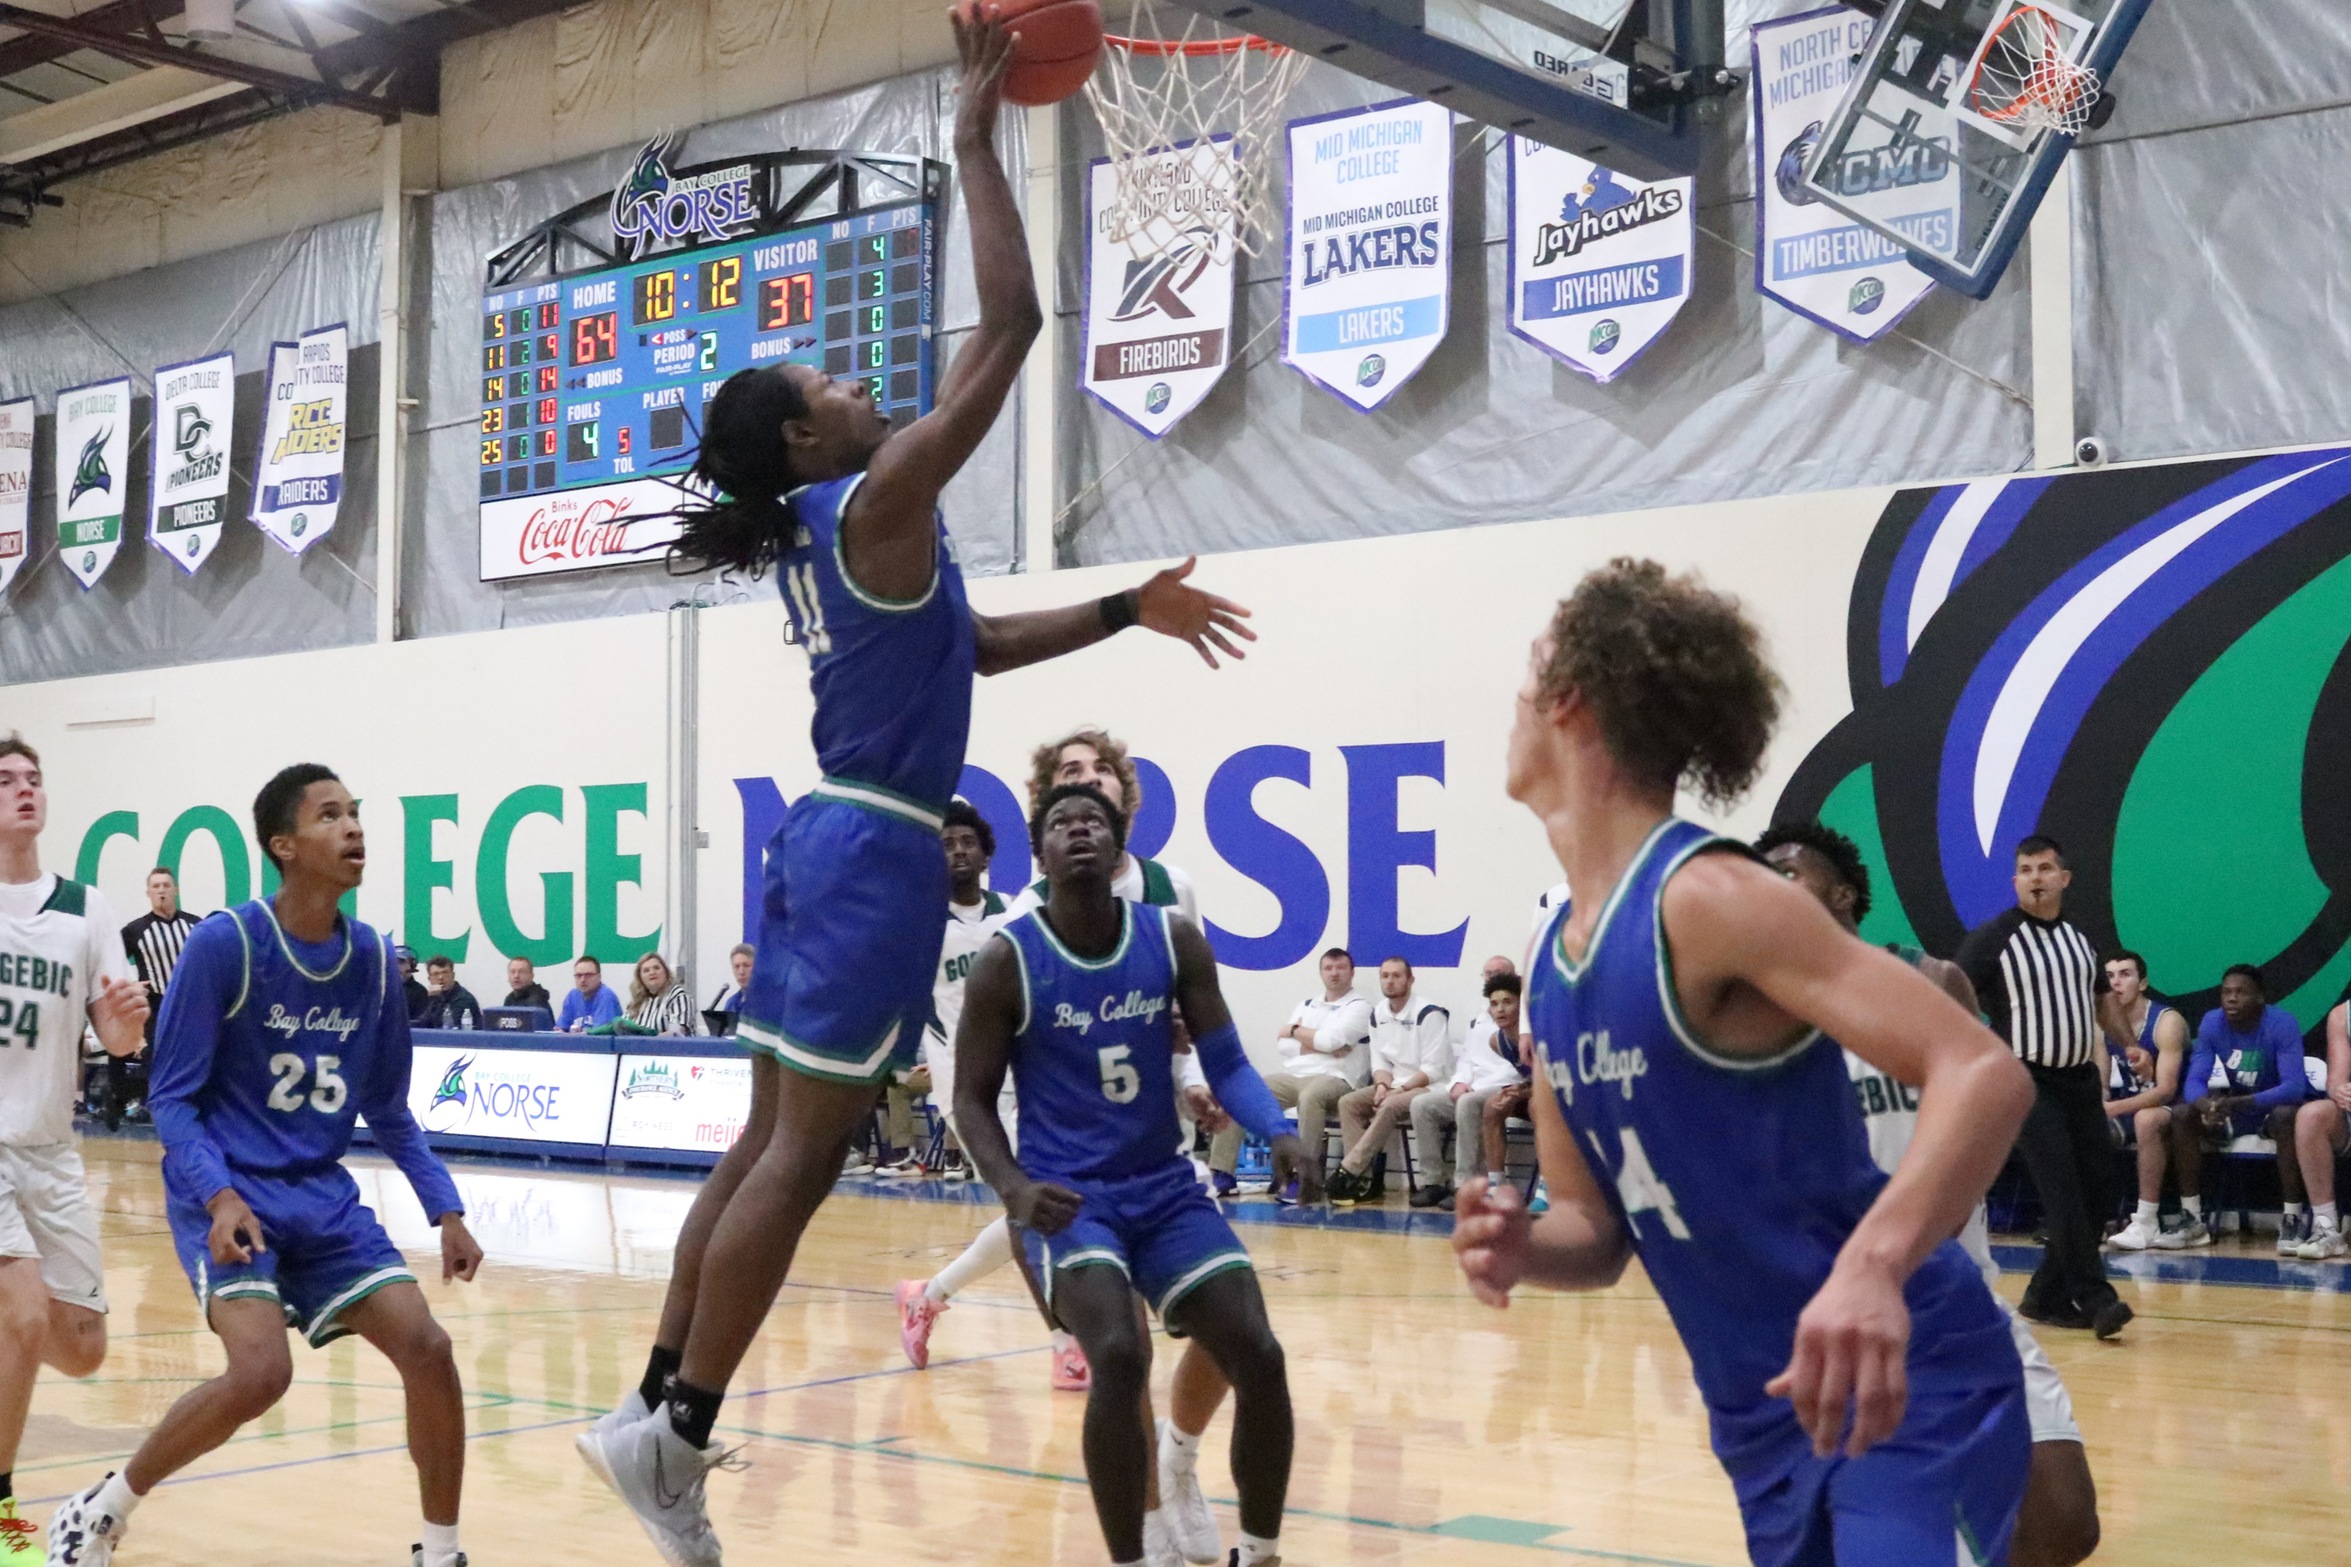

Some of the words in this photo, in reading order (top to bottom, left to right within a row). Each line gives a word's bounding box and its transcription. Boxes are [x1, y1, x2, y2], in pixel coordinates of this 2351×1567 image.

[1780, 26, 1841, 71] NORTH
[1315, 133, 1342, 164] MID
[1349, 120, 1422, 152] MICHIGAN
[675, 178, 697, 193] BAY
[700, 166, 749, 187] COLLEGE
[1337, 150, 1400, 184] COLLEGE
[630, 178, 757, 261] NORSE
[867, 215, 876, 232] F
[893, 208, 916, 228] PTS
[1303, 216, 1322, 234] MID
[1325, 204, 1383, 229] MICHIGAN
[1386, 196, 1439, 215] COLLEGE
[1534, 187, 1682, 266] Jayhawks
[833, 221, 849, 240] NO
[754, 239, 818, 272] VISITOR
[873, 236, 884, 260] 4
[1302, 220, 1439, 288] LAKERS
[537, 284, 557, 300] PTS
[574, 281, 616, 309] HOME
[873, 271, 884, 297] 3
[1552, 264, 1659, 312] JAYHAWKS
[489, 295, 503, 312] NO
[517, 290, 524, 305] F
[767, 274, 813, 329] 37
[494, 314, 504, 338] 5
[522, 309, 531, 332] 0
[542, 303, 559, 328] 11
[872, 306, 883, 332] 0
[1339, 306, 1404, 344] LAKERS
[547, 334, 558, 358] 9
[576, 313, 617, 364] 64
[663, 329, 686, 344] POSS
[752, 337, 791, 360] BONUS
[489, 346, 504, 369] 11
[521, 341, 530, 364] 2
[654, 343, 695, 365] PERIOD
[700, 332, 717, 370] 2
[872, 341, 883, 367] 0
[1120, 337, 1201, 374] FIREBIRDS
[166, 376, 187, 400] DELTA
[189, 371, 221, 391] COLLEGE
[312, 364, 345, 385] COLLEGE
[521, 373, 530, 396] 0
[541, 366, 558, 391] 14
[587, 368, 623, 389] BONUS
[488, 377, 503, 400] 14
[643, 387, 685, 409] PLAYER
[85, 394, 117, 414] COLLEGE
[289, 398, 332, 430] RCC
[526, 402, 530, 425] 1
[541, 398, 557, 424] 10
[567, 401, 600, 422] FOULS
[482, 407, 502, 433] 23
[481, 439, 502, 464] 25
[520, 434, 529, 458] 0
[545, 428, 556, 453] 0
[583, 422, 598, 458] 4
[618, 429, 630, 454] 5
[167, 450, 223, 490] PIONEERS
[614, 458, 635, 475] TOL
[174, 499, 216, 527] PIONEERS
[552, 500, 577, 514] Binks
[76, 519, 105, 543] NORSE
[520, 497, 634, 566] Coca-Cola
[75, 781, 664, 968] COEGE
[264, 1003, 299, 1039] Bay
[304, 1006, 360, 1042] College
[1054, 1003, 1093, 1035] Bay
[1101, 990, 1165, 1025] College
[266, 1052, 347, 1114] 25
[475, 1071, 490, 1081] BAY
[494, 1072, 532, 1083] COLLEGE
[1099, 1044, 1141, 1105] 5
[464, 1082, 560, 1132] NORSE
